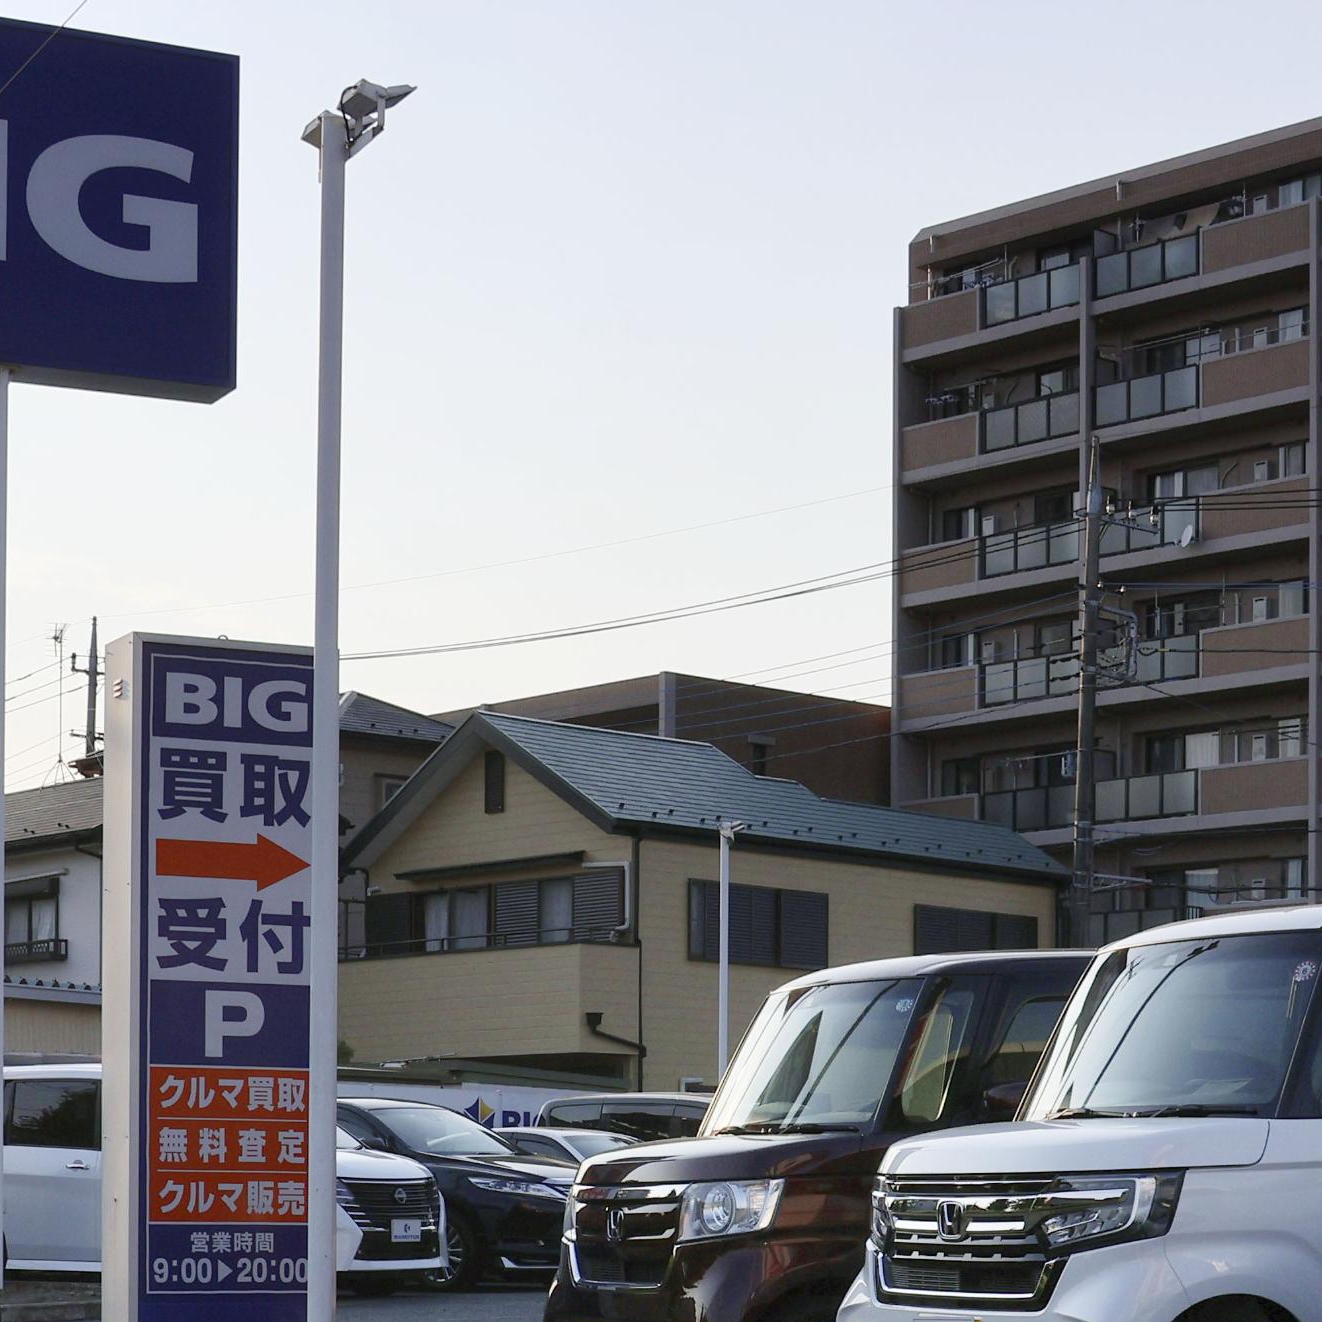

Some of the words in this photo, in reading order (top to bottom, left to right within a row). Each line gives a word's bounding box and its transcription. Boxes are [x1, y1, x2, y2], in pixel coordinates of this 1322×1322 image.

[165, 671, 309, 733] BIG
[157, 747, 311, 829] 買取
[156, 896, 311, 974] 受付
[204, 989, 265, 1058] P
[158, 1075, 305, 1113] クルマ買取
[158, 1127, 306, 1164] 無料査定
[158, 1179, 306, 1217] クルマ販売
[190, 1231, 275, 1254] 営業時間
